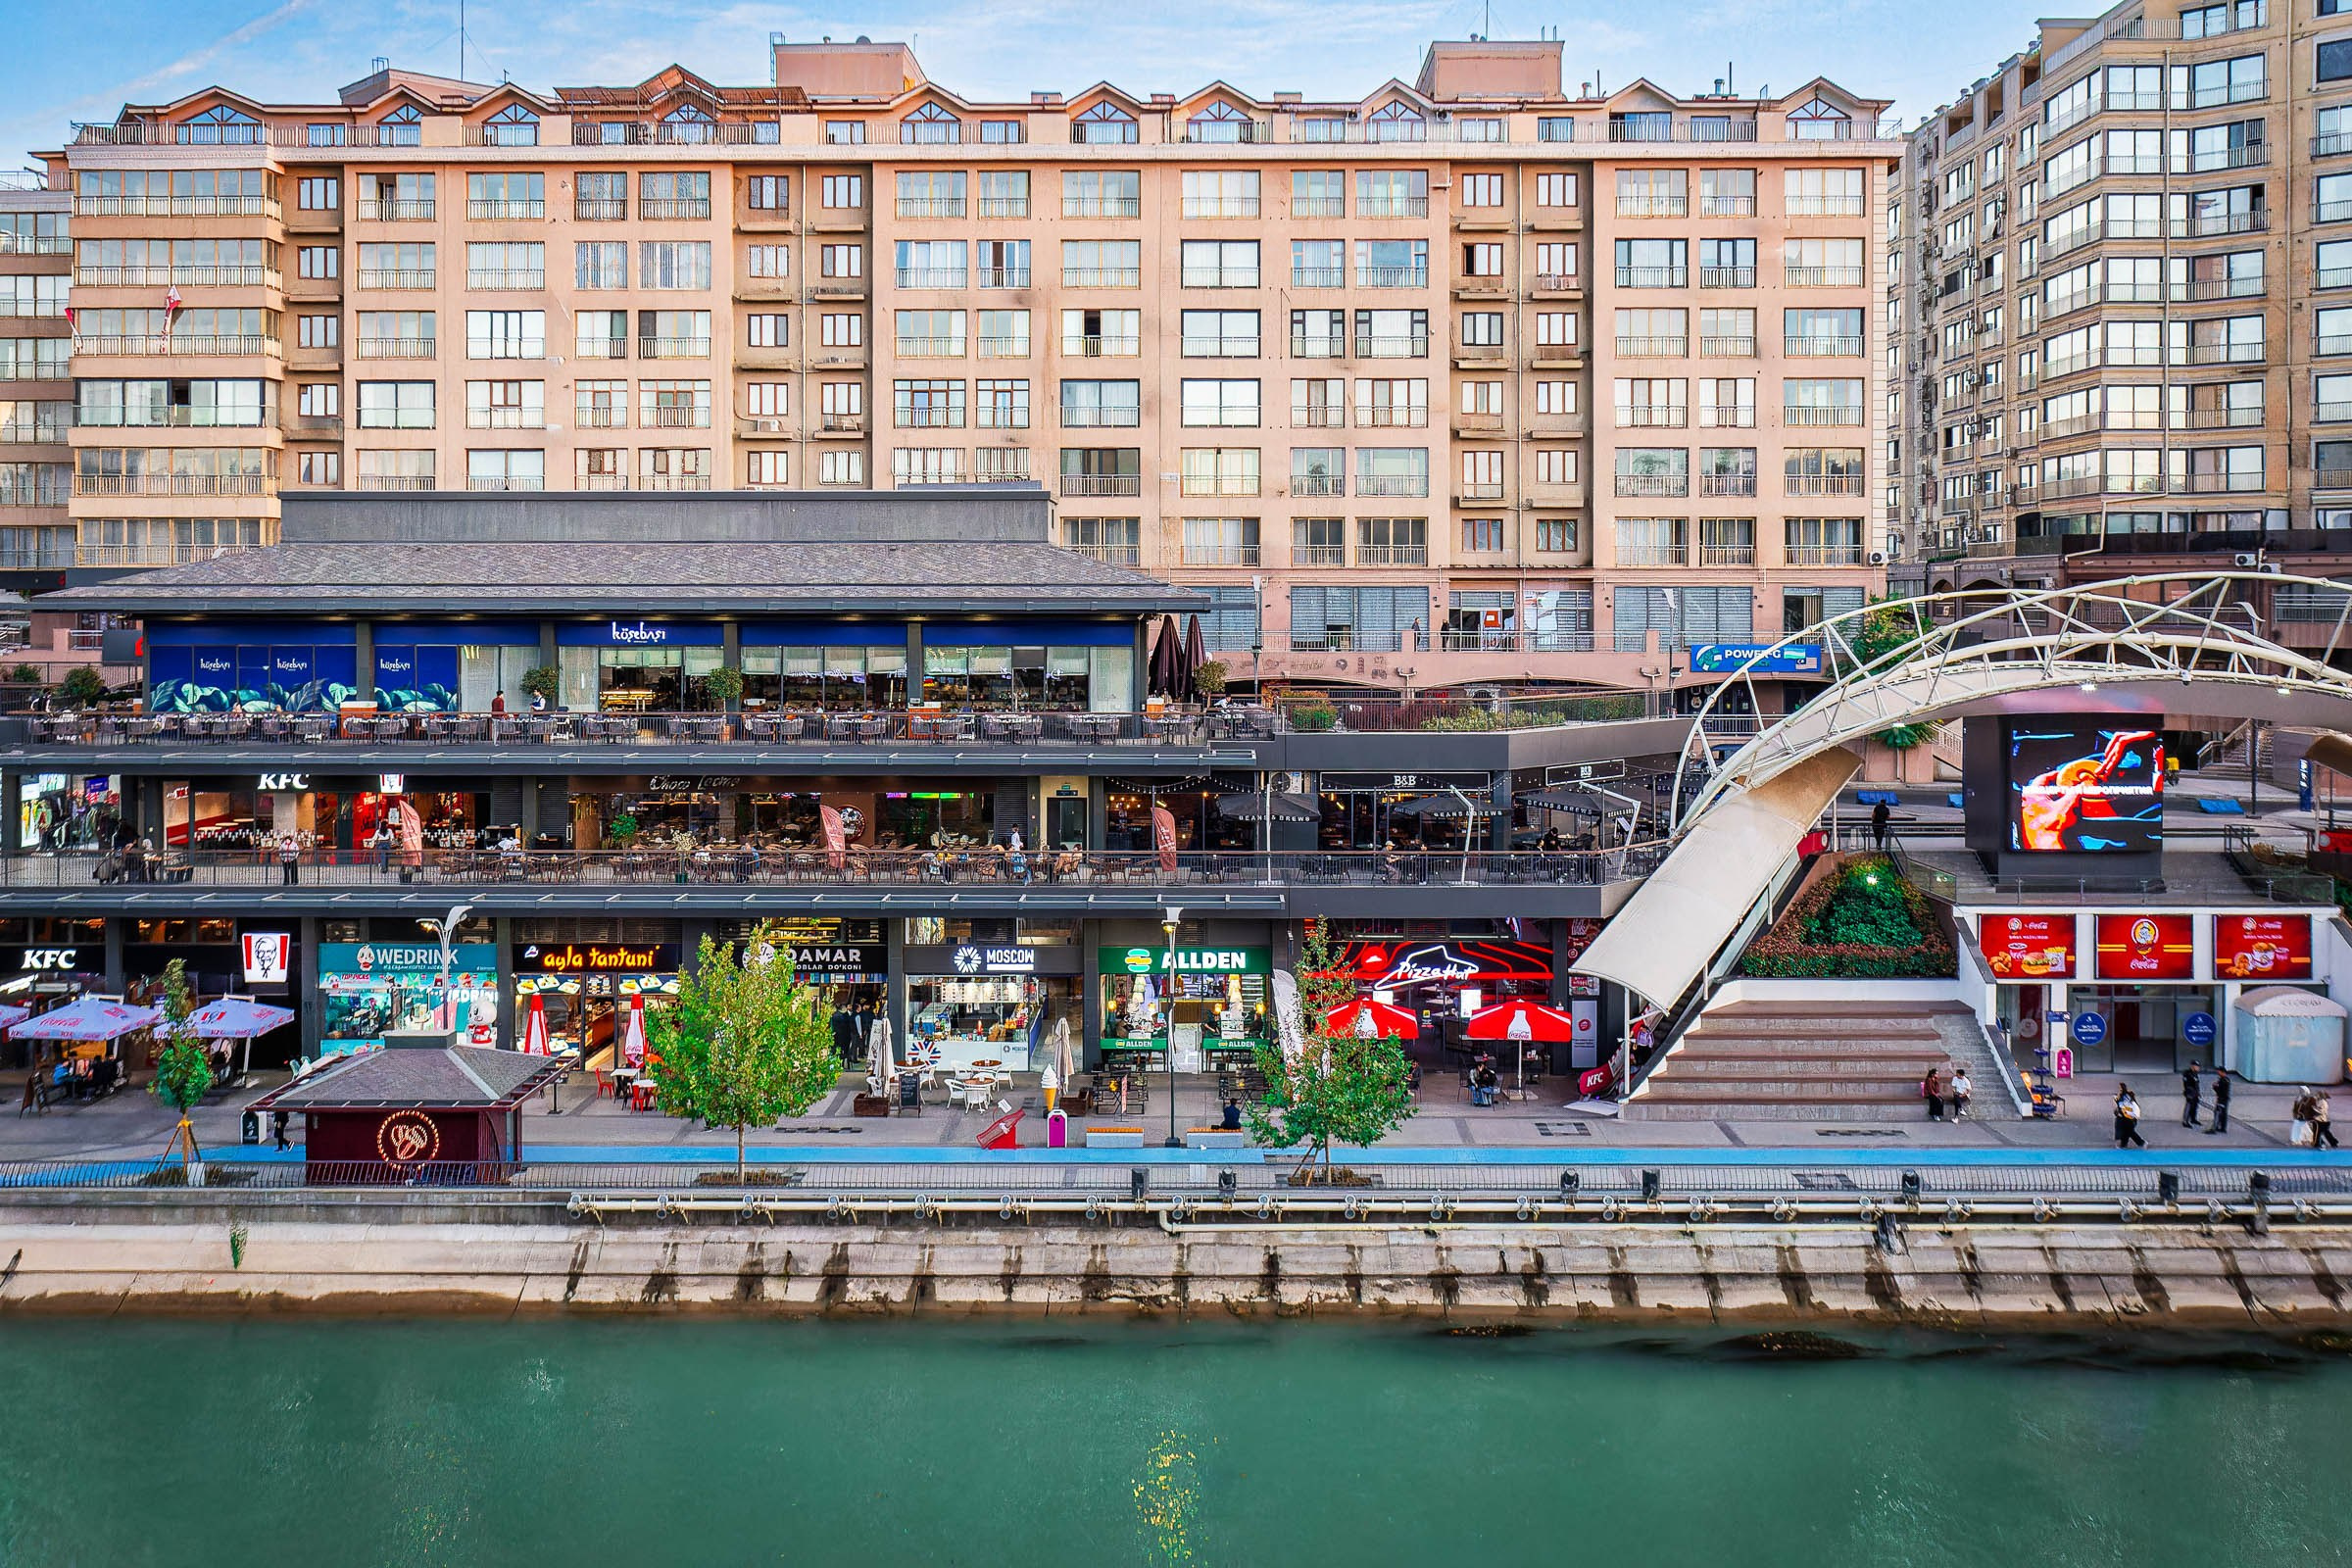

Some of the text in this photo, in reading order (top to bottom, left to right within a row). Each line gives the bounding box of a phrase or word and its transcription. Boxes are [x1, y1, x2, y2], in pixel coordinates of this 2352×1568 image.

[257, 773, 310, 790] KFC
[1394, 775, 1417, 785] B&B
[21, 949, 76, 969] KFC
[376, 949, 459, 965] WEDRINK
[544, 944, 661, 970] ayla tantuni
[986, 950, 1035, 963] MOSCOW
[1161, 952, 1247, 969] ALLDEN
[1396, 960, 1471, 980] Pizza Hut
[1586, 1072, 1604, 1087] KFC
